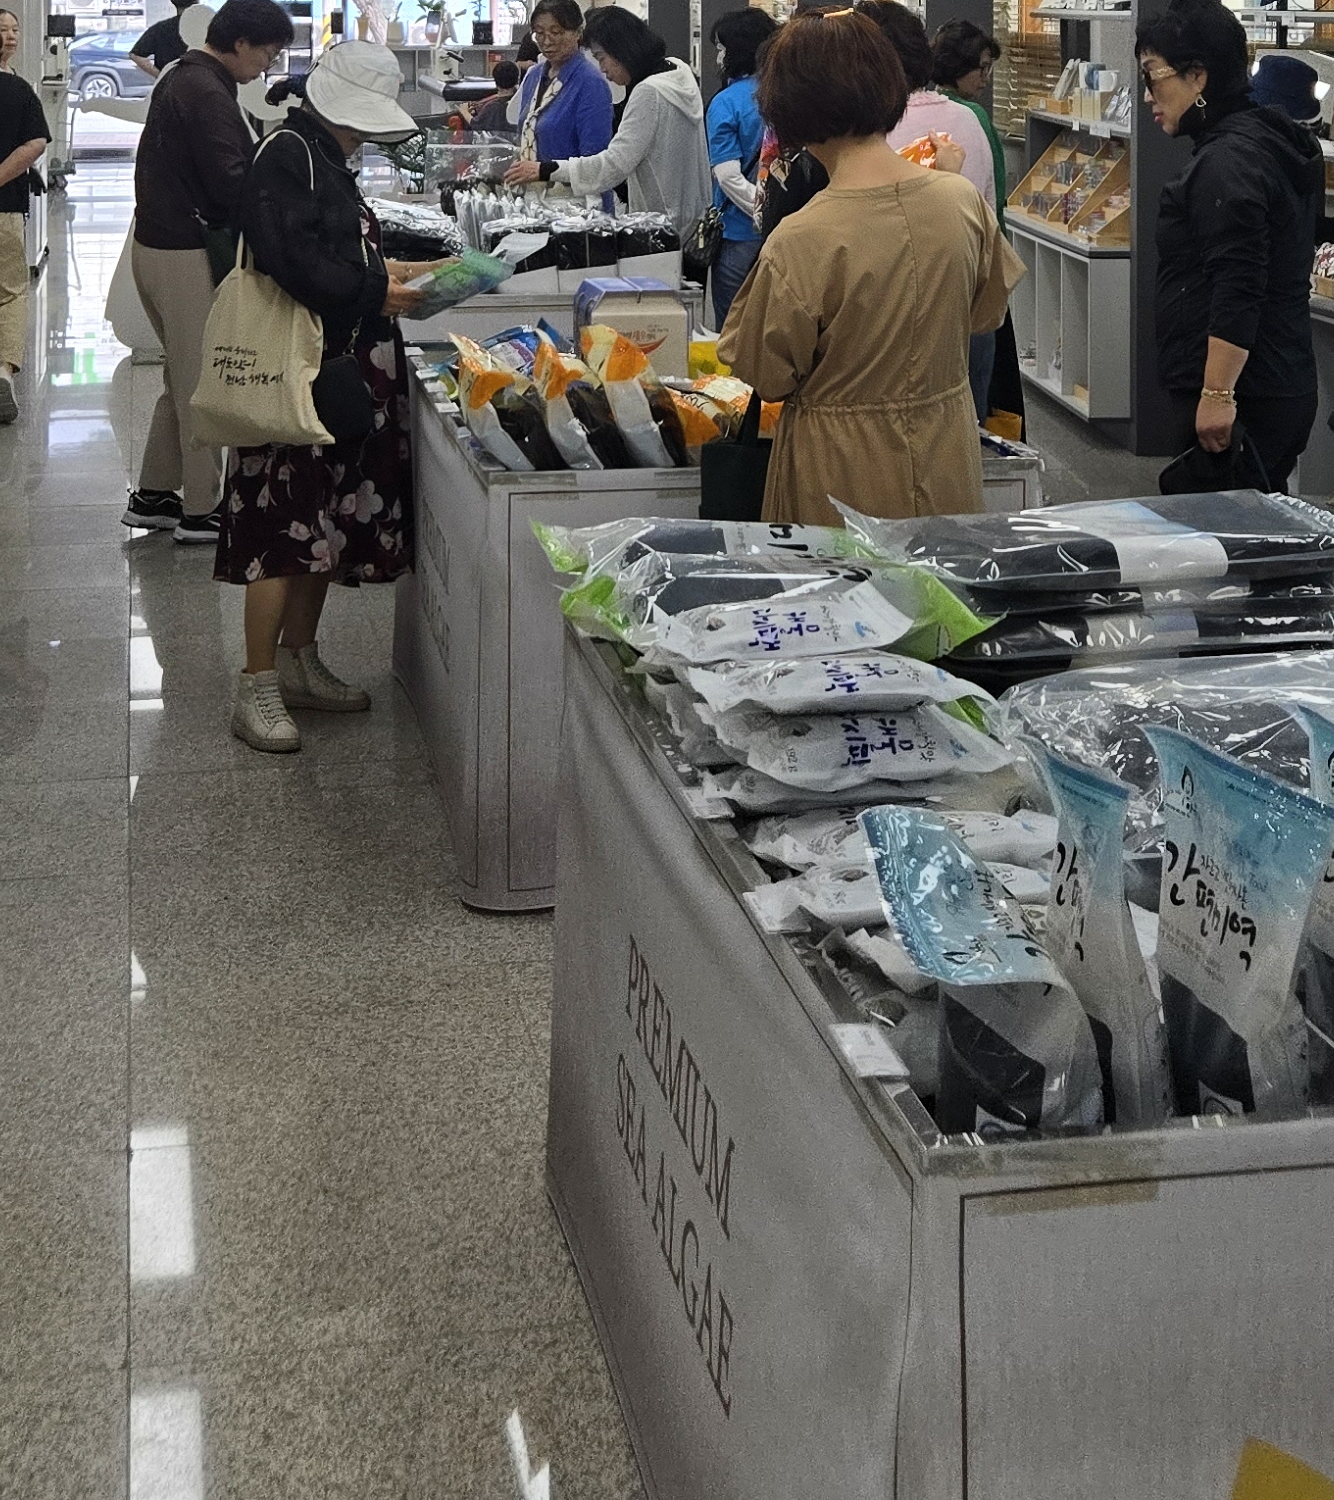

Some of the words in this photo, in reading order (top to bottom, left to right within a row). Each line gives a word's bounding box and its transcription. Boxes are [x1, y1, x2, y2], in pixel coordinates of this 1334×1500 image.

[614, 1052, 649, 1204] SEA
[652, 1153, 734, 1419] ALGAE
[625, 934, 736, 1240] PREMIUM
